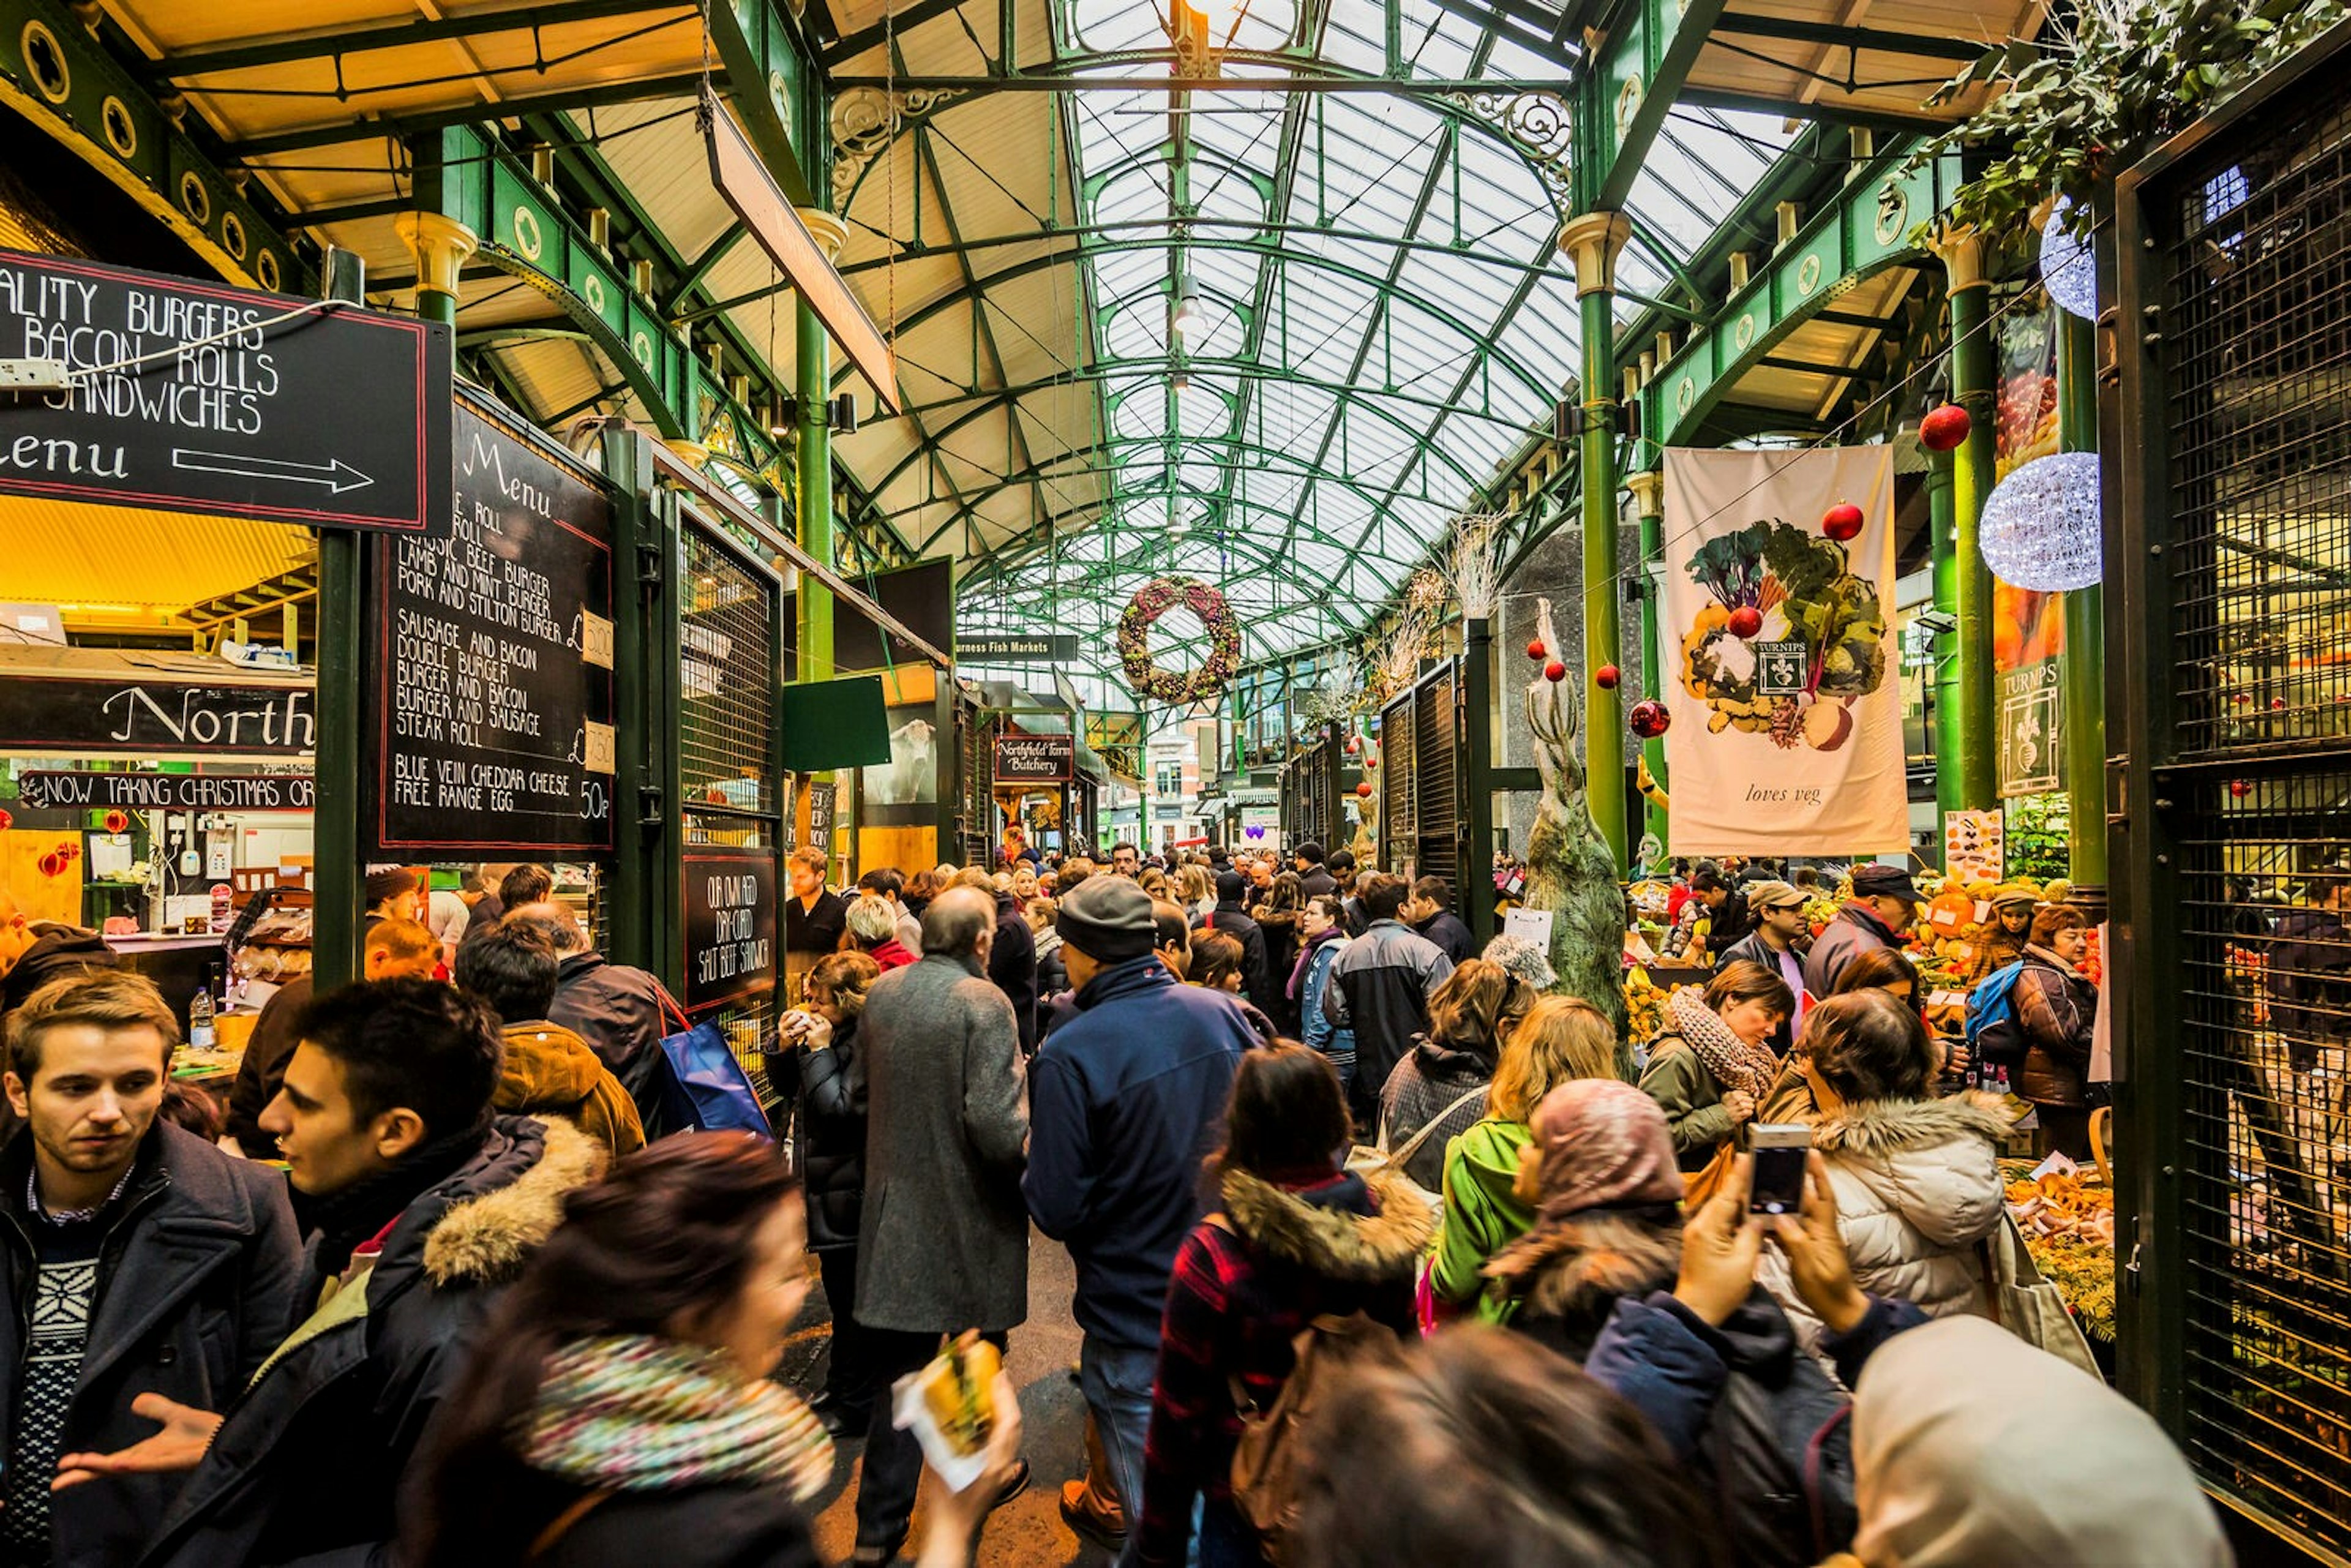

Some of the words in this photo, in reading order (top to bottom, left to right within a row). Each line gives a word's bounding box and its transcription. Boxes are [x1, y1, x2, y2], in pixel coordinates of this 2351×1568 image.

[129, 290, 264, 351] BURGERS
[24, 317, 141, 375] BACON
[178, 343, 279, 397] ROLLS
[0, 435, 129, 479] enu
[463, 433, 551, 518] Menu
[453, 513, 483, 547] ROLL
[475, 501, 503, 536] ROLL
[399, 539, 437, 577] LAMB
[443, 559, 470, 589] AND
[473, 570, 502, 600] MINT
[508, 584, 550, 620] BURGER
[467, 544, 495, 574] BEEF
[504, 560, 550, 599] BURGER
[399, 566, 435, 601] PORK
[439, 582, 465, 610] AND
[470, 591, 517, 628] STILTON
[521, 612, 562, 645] BURGER
[397, 607, 461, 650] SAUSAGE
[469, 631, 495, 659] AND
[501, 639, 538, 670] BACON
[989, 641, 1008, 653] Fish
[1011, 641, 1048, 653] Markets
[1758, 642, 1806, 652] TURNIPS
[397, 637, 449, 671] DOUBLE
[457, 652, 509, 685] BURGER
[2004, 664, 2057, 696] TURNPS
[397, 661, 450, 694] BURGER
[456, 677, 481, 701] AND
[489, 683, 527, 710] BACON
[102, 686, 315, 745] North
[396, 685, 452, 719] BURGER
[456, 698, 483, 725] AND
[489, 705, 541, 737] SAUSAGE
[396, 712, 443, 741] STEAK
[451, 721, 482, 748] ROLL
[997, 741, 1046, 760] Northfield
[1007, 757, 1057, 775] Butchery
[42, 776, 94, 804] NOW
[104, 776, 172, 806] TAKING
[179, 779, 280, 806] CHRISTMAS
[289, 779, 315, 807] OR
[395, 781, 431, 806] FREE
[438, 785, 482, 811] RANGE
[491, 791, 514, 812] EGG
[396, 754, 430, 781] BLUE
[437, 760, 466, 786] VEIN
[471, 763, 526, 792] CHEDDAR
[529, 774, 570, 797] CHEESE
[1745, 783, 1787, 801] loves
[1795, 788, 1821, 805] veg
